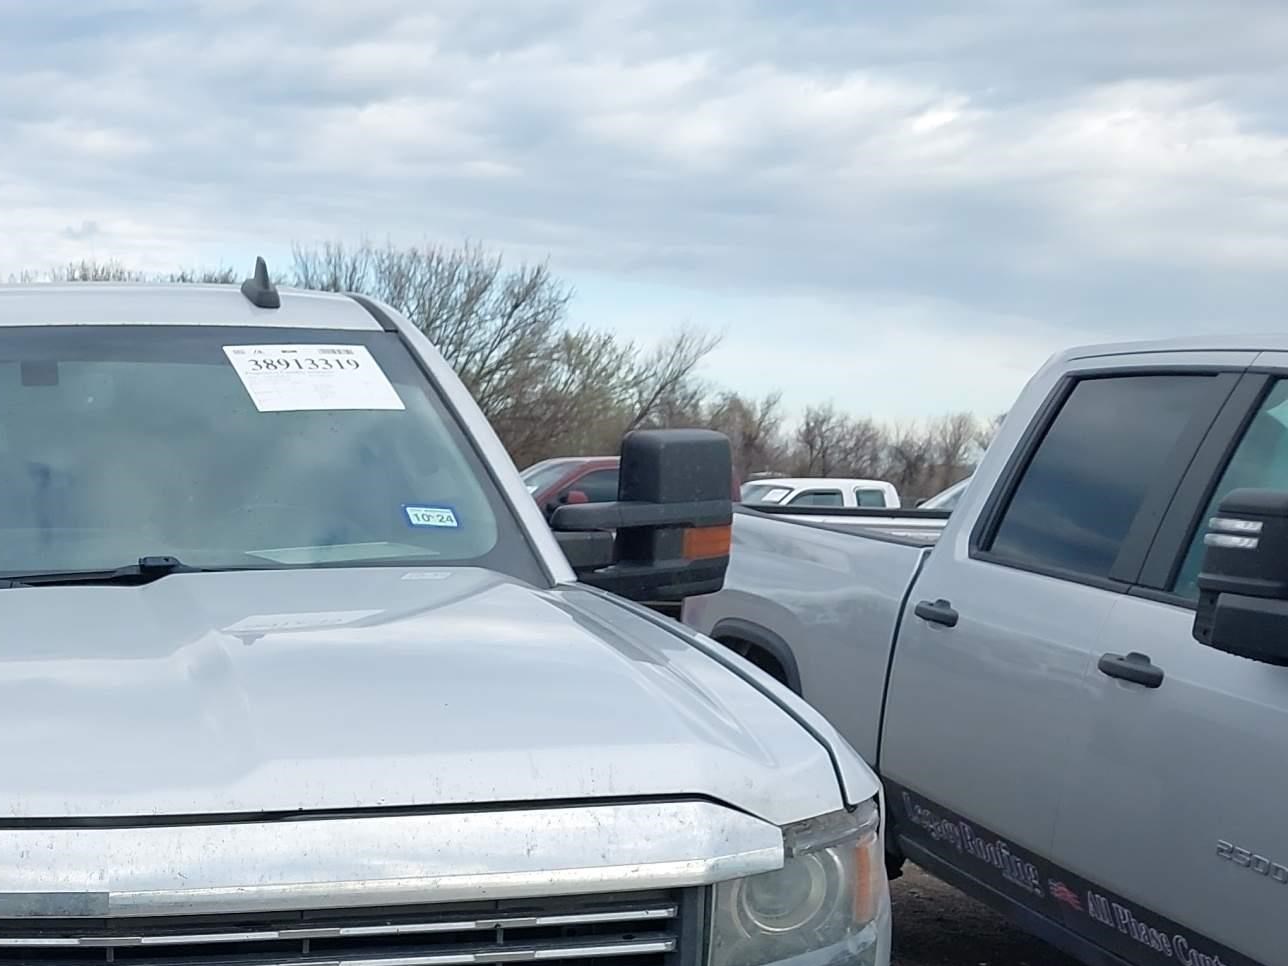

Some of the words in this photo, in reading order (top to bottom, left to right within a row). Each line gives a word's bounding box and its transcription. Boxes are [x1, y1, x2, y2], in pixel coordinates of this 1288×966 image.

[247, 358, 360, 371] 38913319
[1087, 890, 1114, 927] All
[1112, 902, 1173, 957] Phase
